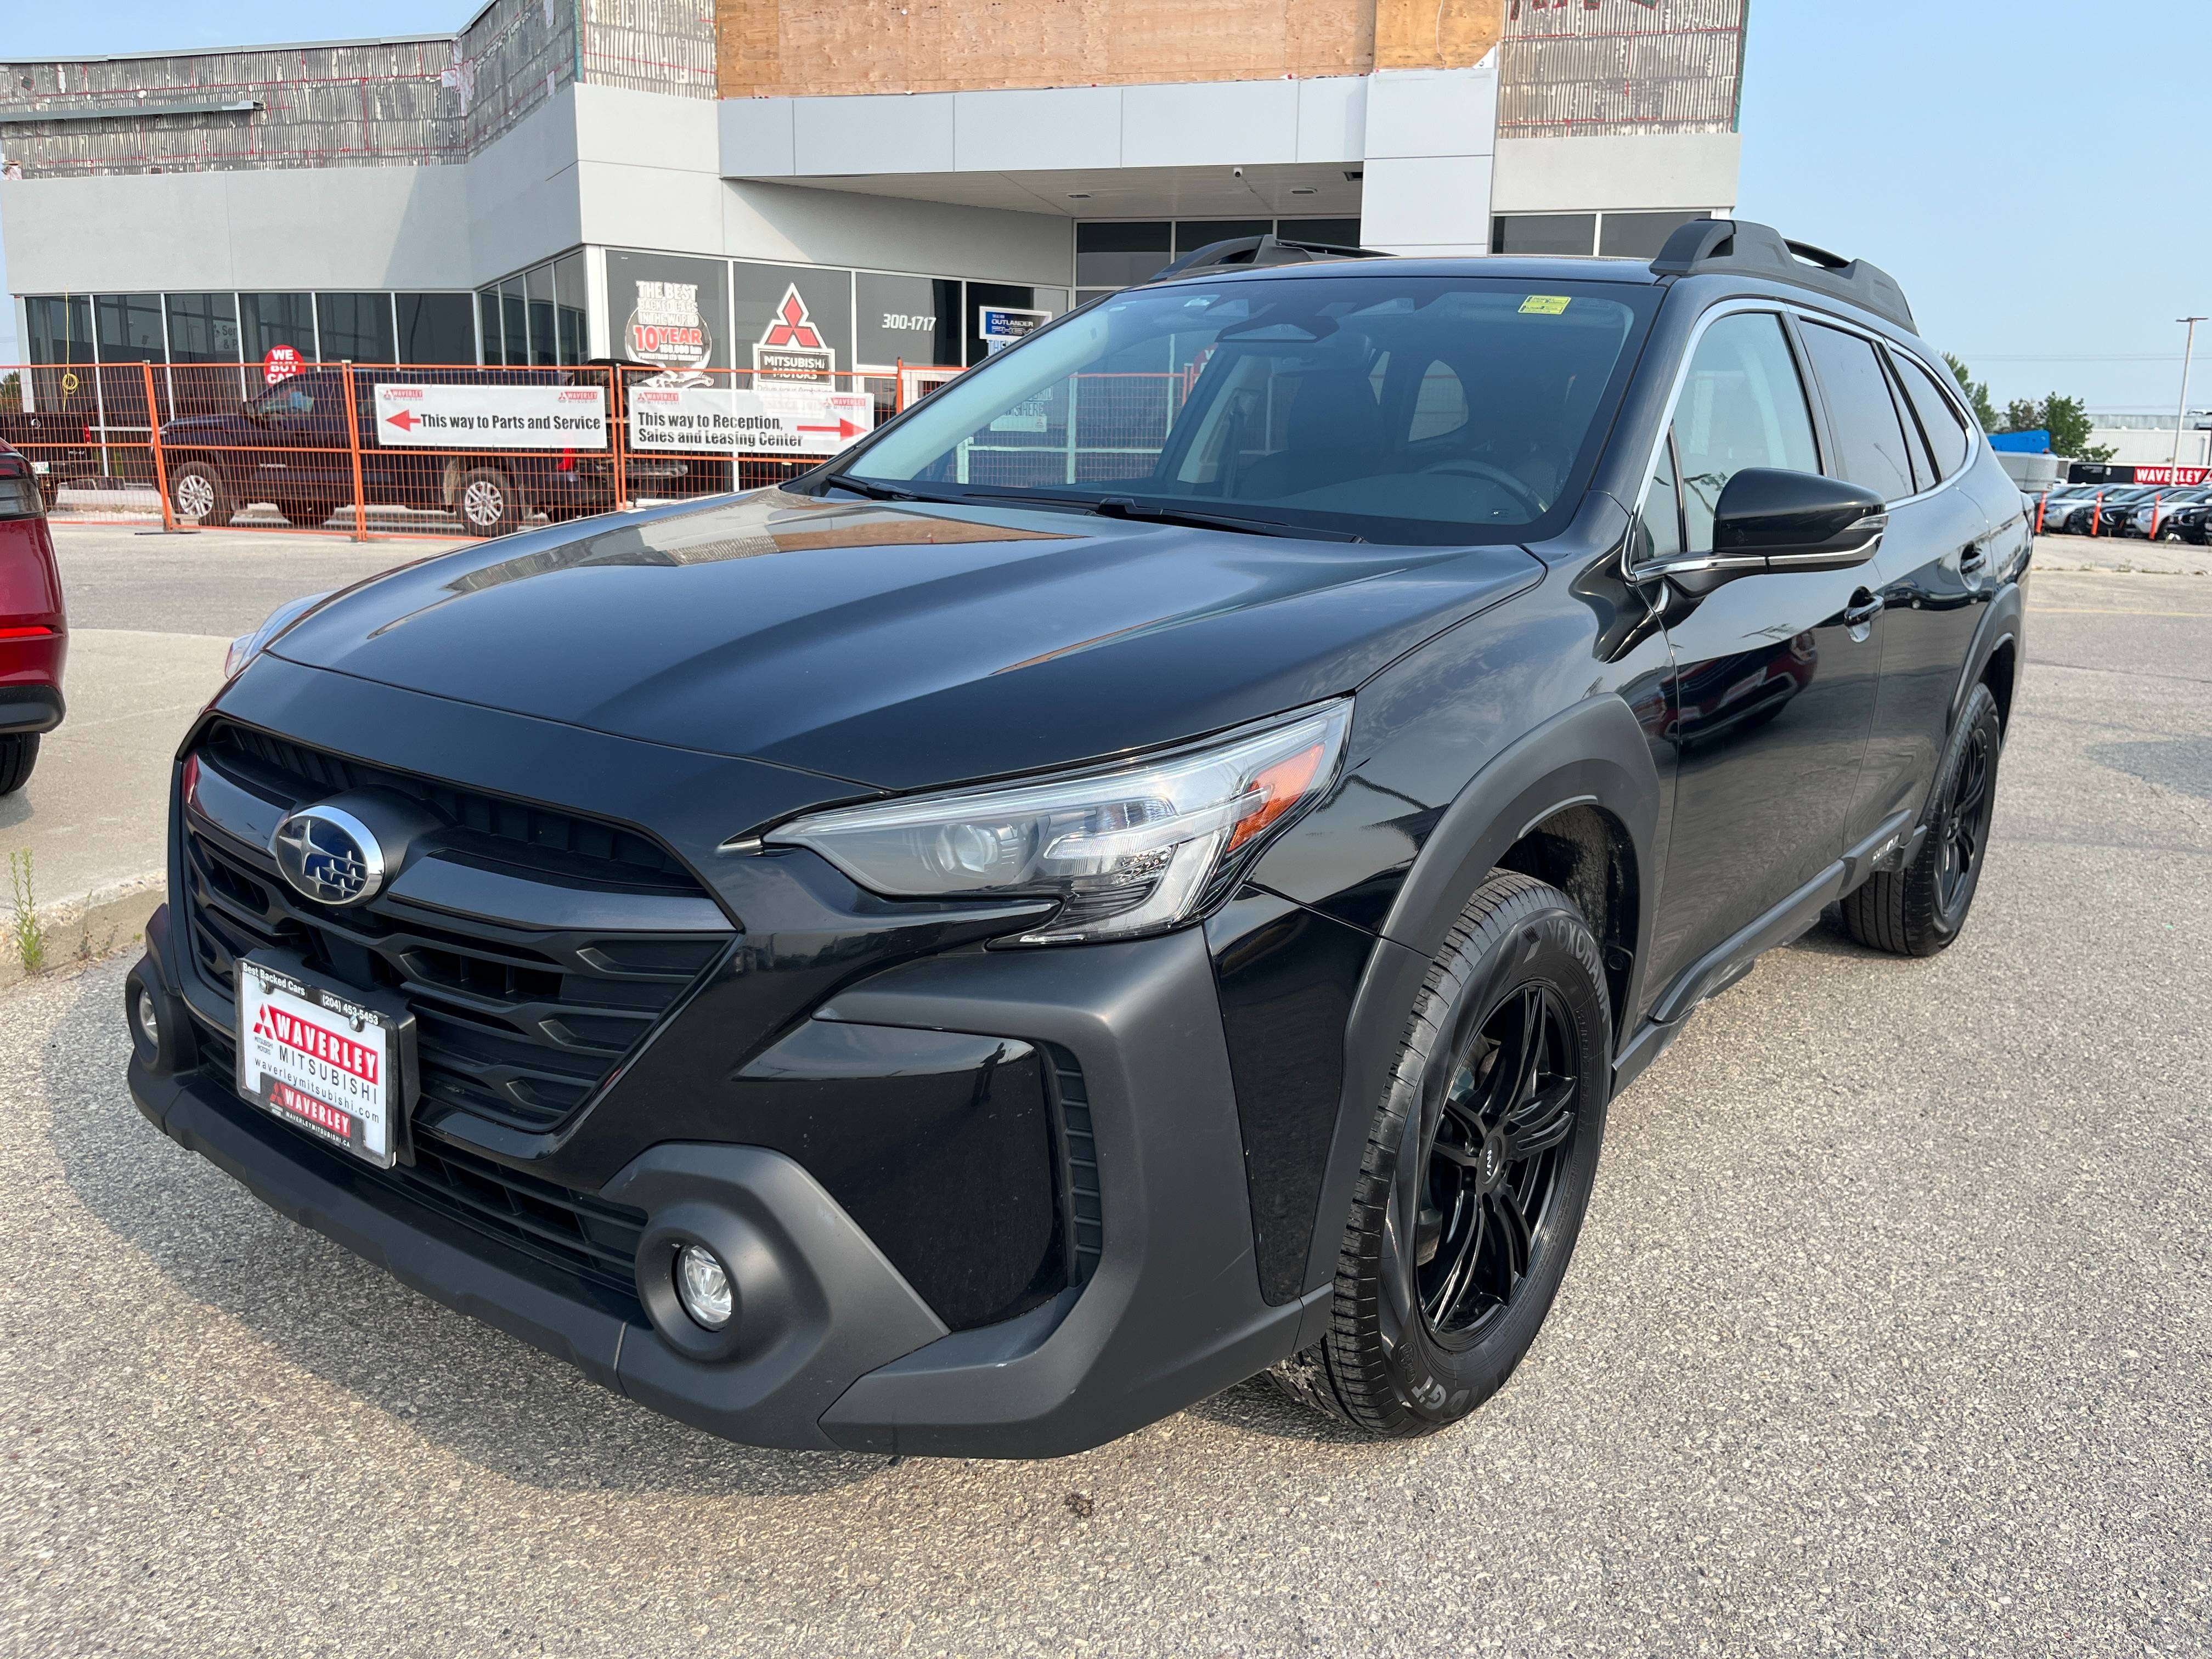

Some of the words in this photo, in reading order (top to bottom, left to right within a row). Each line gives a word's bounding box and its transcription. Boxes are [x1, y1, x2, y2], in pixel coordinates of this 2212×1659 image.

[636, 280, 663, 299] THE
[664, 282, 698, 302] BEST
[639, 299, 673, 312] BACKED
[649, 312, 667, 324] THE
[667, 314, 698, 326] WORLD
[882, 313, 936, 331] 300-1717
[991, 319, 1034, 327] OUTLANDER
[634, 326, 659, 352] 10
[659, 326, 703, 345] YEAR
[272, 349, 294, 360] WE
[764, 356, 825, 369] MITSUBISHI
[270, 362, 298, 373] BUY
[772, 368, 817, 380] MOTORS
[421, 414, 447, 427] This
[450, 417, 474, 430] way
[477, 416, 489, 428] to
[492, 415, 524, 429] Parts
[528, 416, 550, 429] and
[554, 416, 601, 430] Service
[638, 412, 665, 426] This
[668, 415, 693, 429] way
[696, 415, 709, 427] to
[713, 414, 783, 431] Reception,
[639, 428, 675, 443] Sales
[678, 430, 701, 444] and
[705, 431, 755, 447] Leasing
[759, 432, 804, 447] Center
[1545, 919, 1612, 1024] YOKOHAMA
[242, 962, 259, 977] Best
[260, 969, 286, 989] Backed
[287, 980, 306, 996] Cars
[323, 994, 341, 1013] (204)
[343, 1003, 379, 1025] 453-5453
[276, 1013, 377, 1079] WAVERLEY
[279, 1045, 377, 1105] MITSUBISHI
[255, 1057, 380, 1124] waverleymitsubishi.com
[285, 1088, 349, 1133] WAVERLEY
[285, 1110, 351, 1148] WAVERLEYMITSUBISHI.CA
